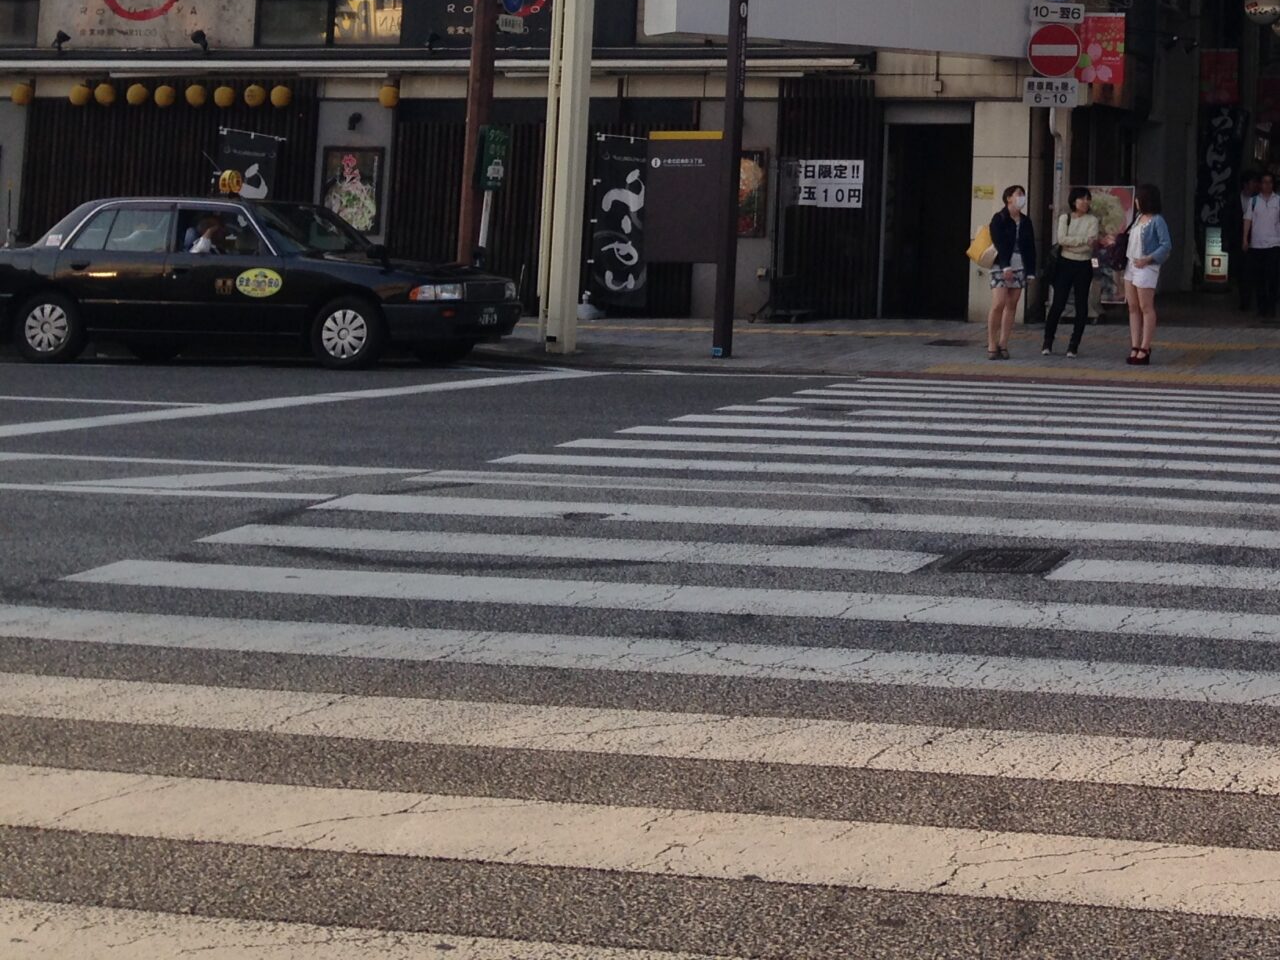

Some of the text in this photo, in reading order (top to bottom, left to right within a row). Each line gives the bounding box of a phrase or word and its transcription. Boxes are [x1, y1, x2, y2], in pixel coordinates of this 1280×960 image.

[1027, 81, 1075, 91] 軽車両を除く
[1034, 94, 1068, 103] 6-10
